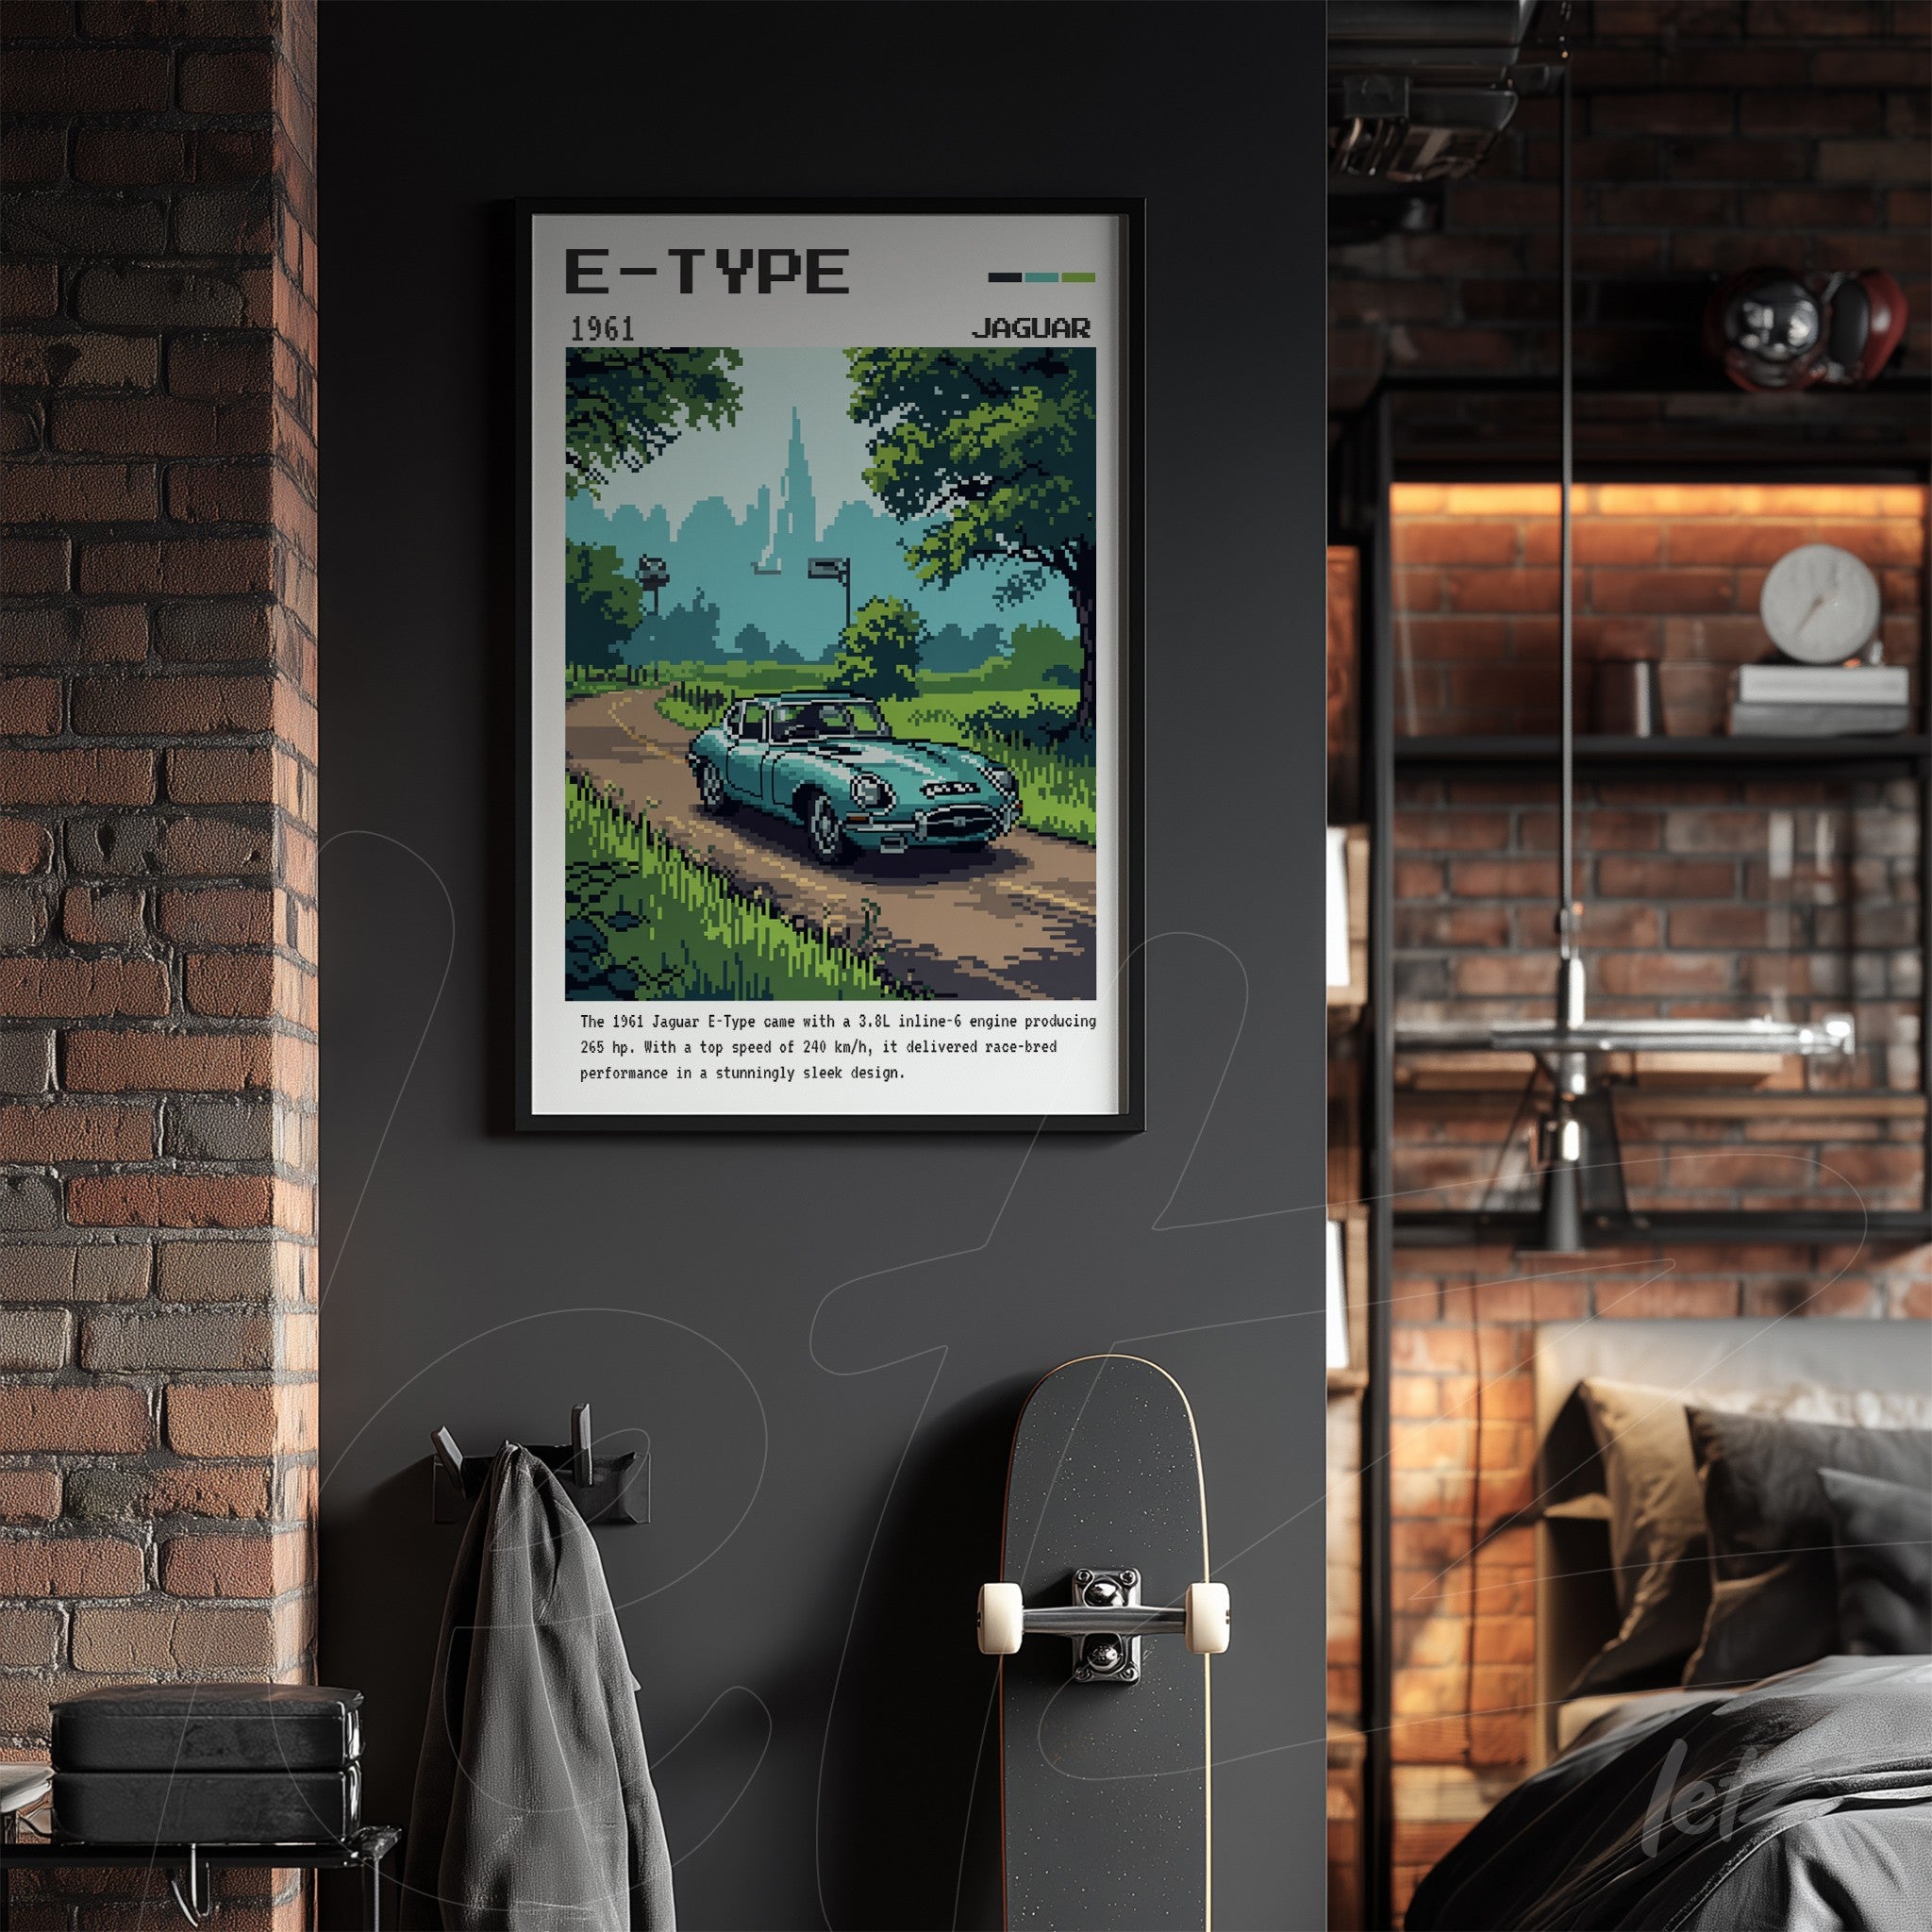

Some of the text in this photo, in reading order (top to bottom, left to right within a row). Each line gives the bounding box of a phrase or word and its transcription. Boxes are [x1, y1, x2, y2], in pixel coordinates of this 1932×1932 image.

[565, 248, 850, 294] E-TYPE
[572, 315, 634, 341] 1961
[971, 317, 1091, 339] JAGUAR
[580, 1013, 1097, 1031] The 1961 Jaguar E-Type came with a 3.8L inline-6 engine producing
[580, 1038, 1058, 1058] 265 hp. With a top speed of 240 km/h, it delivered race-bred
[580, 1065, 904, 1083] performance in a stunningly sleek design.
